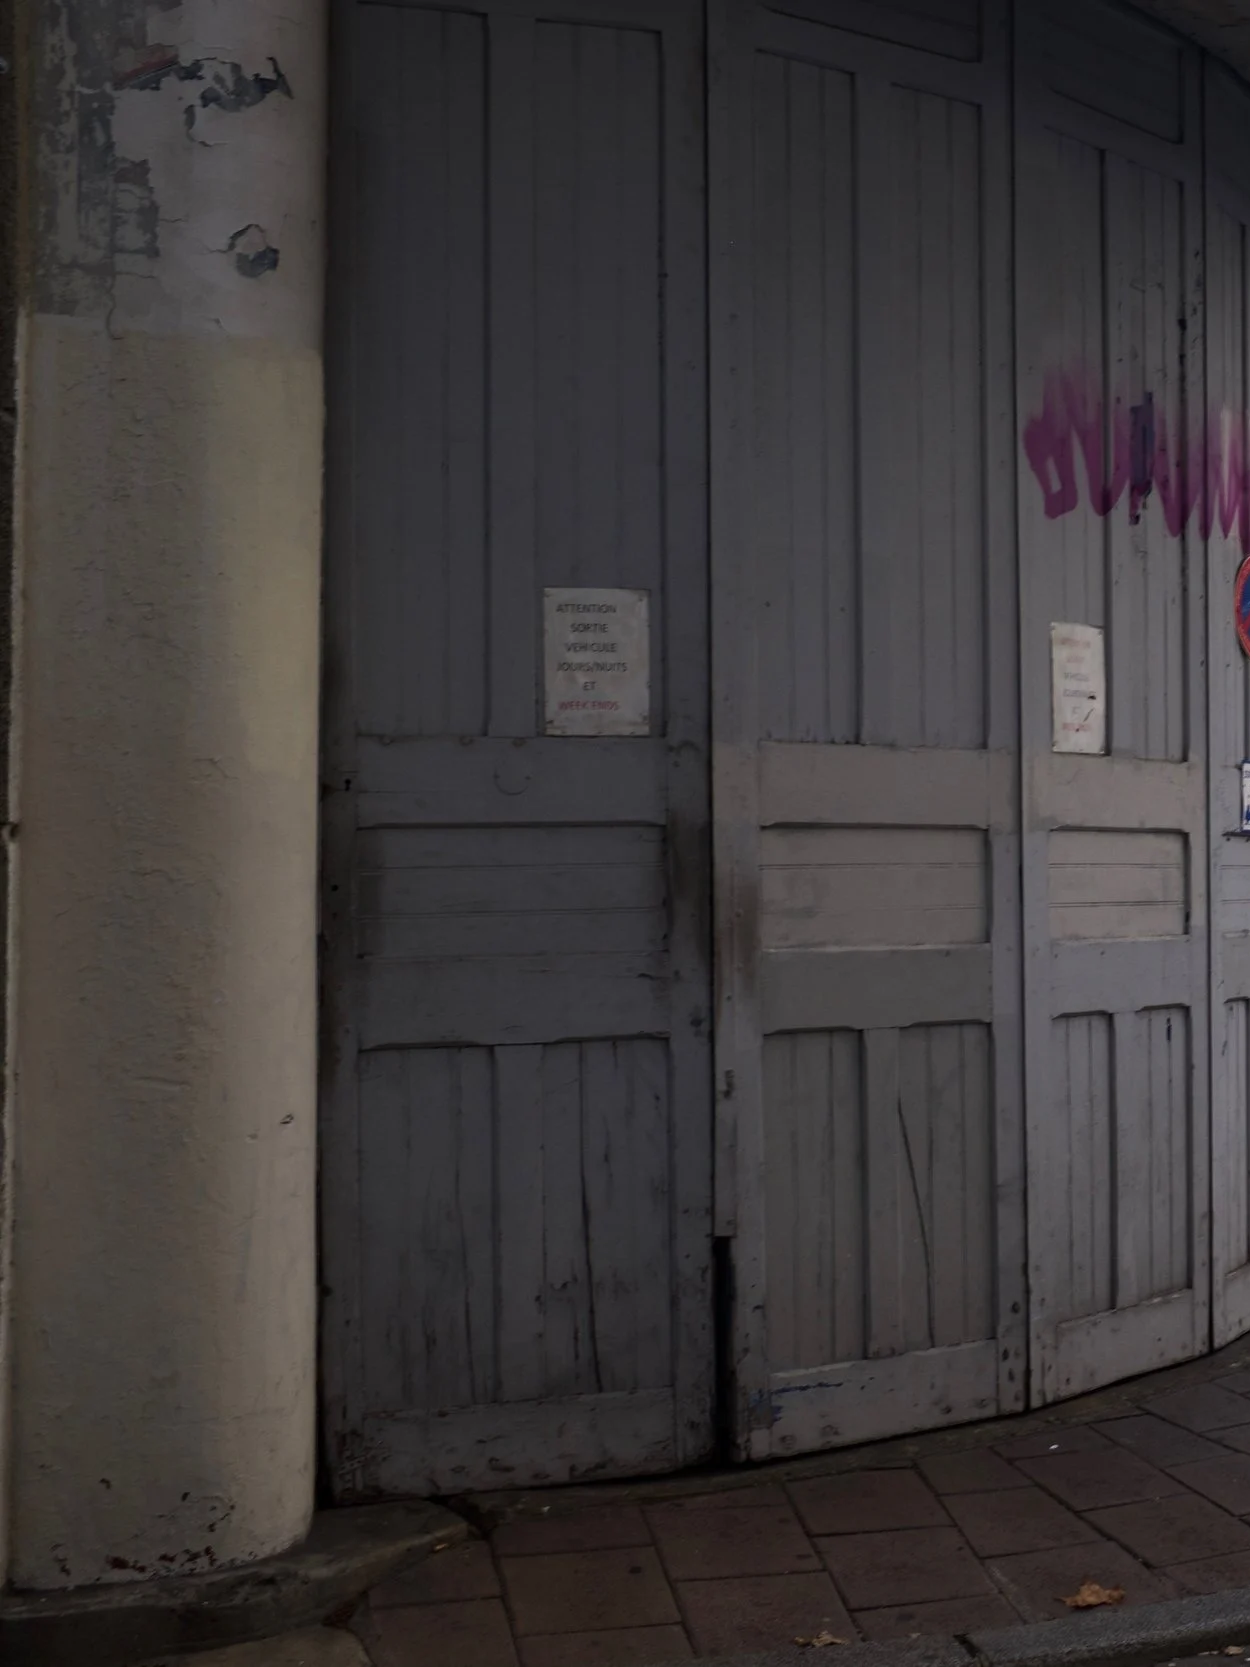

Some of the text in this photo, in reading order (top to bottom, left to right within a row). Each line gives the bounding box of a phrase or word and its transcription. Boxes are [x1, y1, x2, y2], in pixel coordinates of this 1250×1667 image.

[556, 603, 616, 613] ATTENTION
[570, 622, 608, 633] SORTIE
[583, 681, 597, 691] ET
